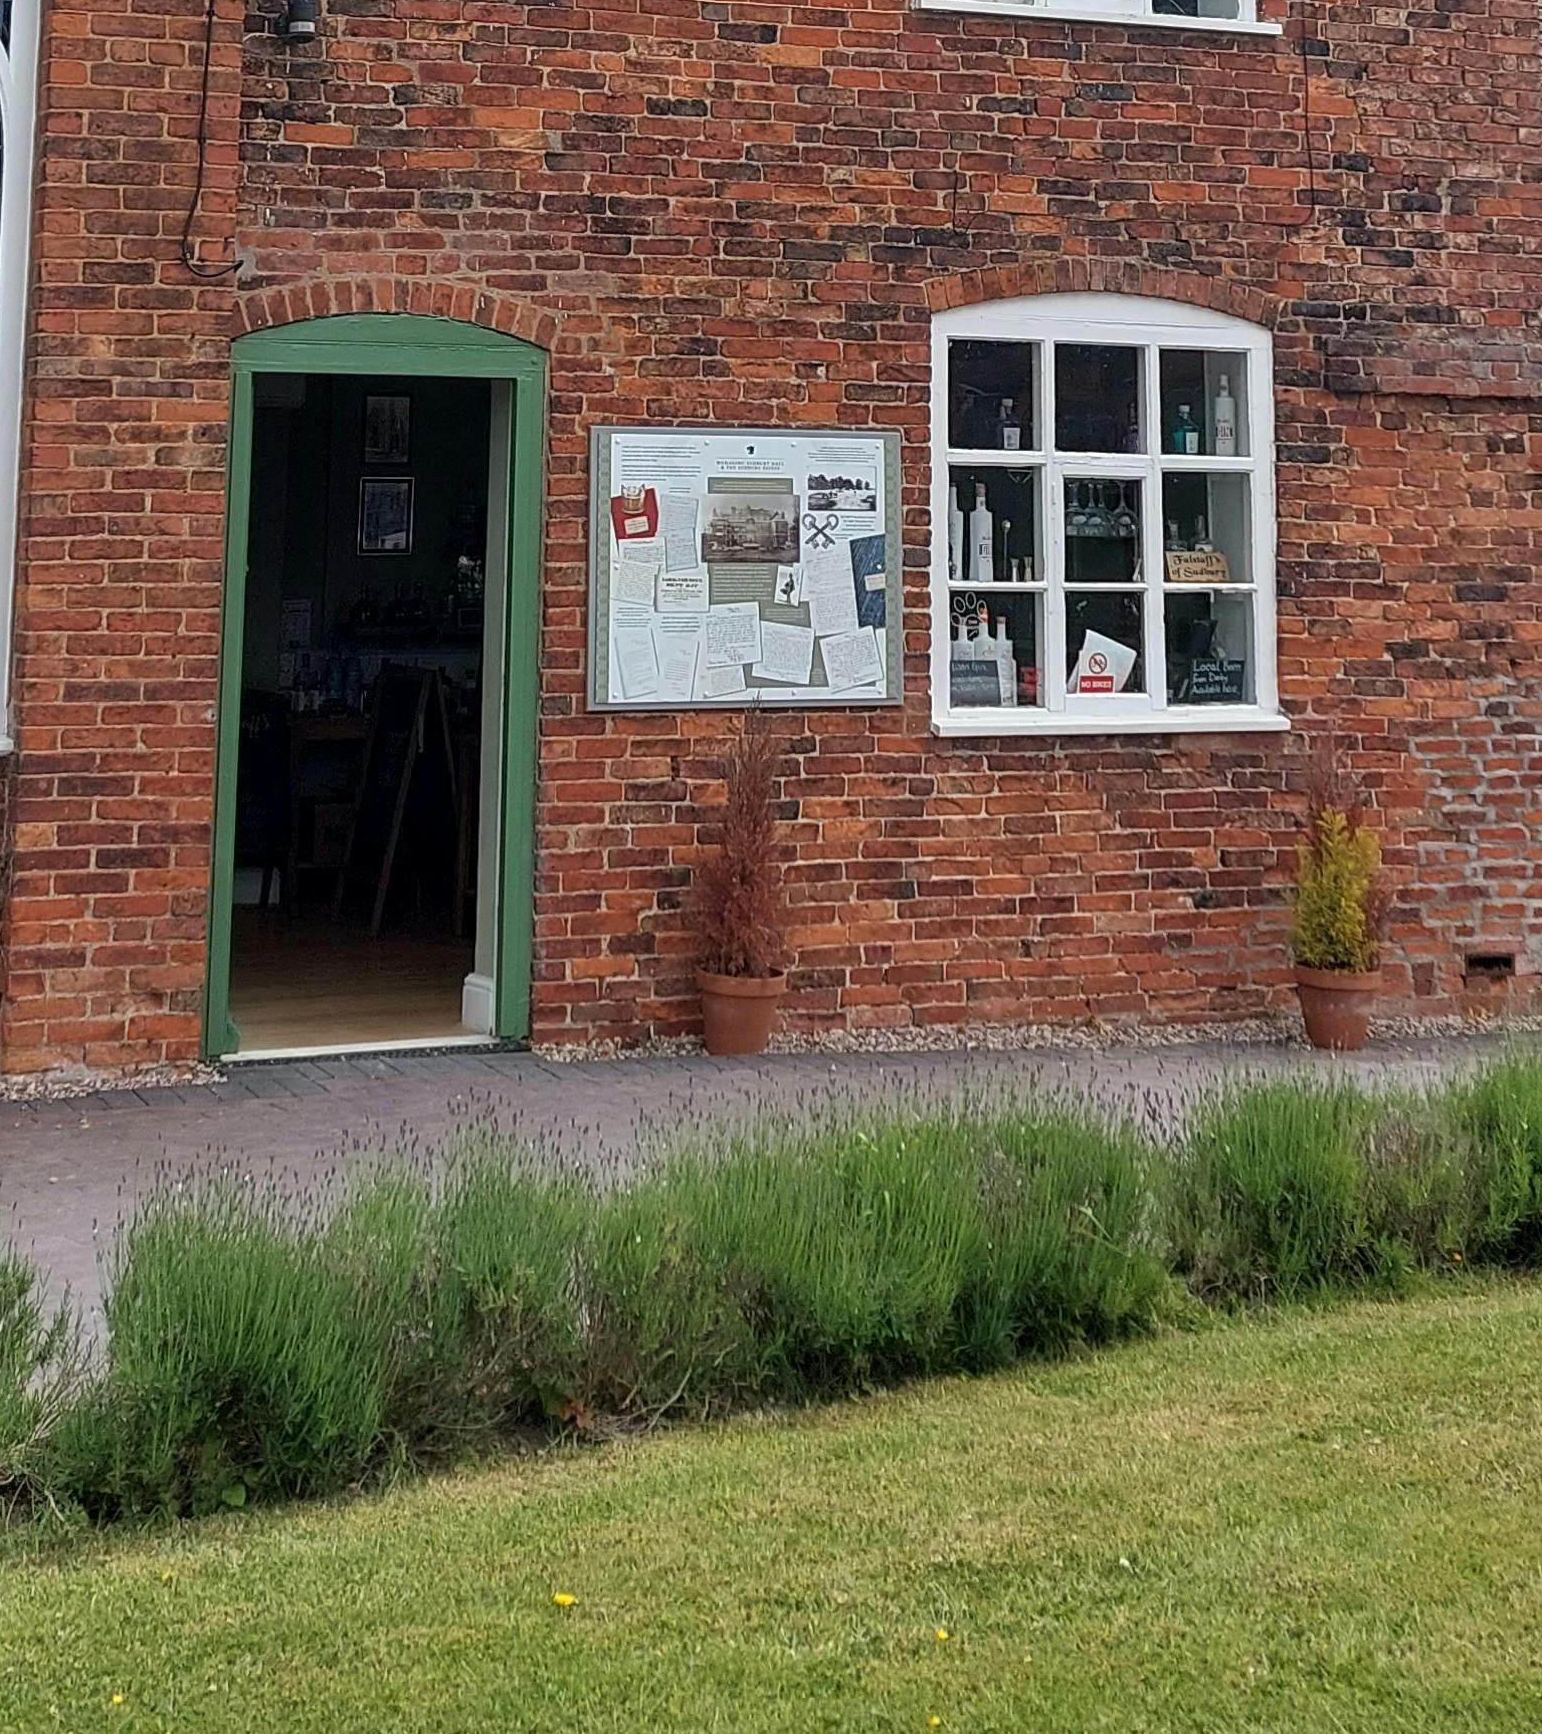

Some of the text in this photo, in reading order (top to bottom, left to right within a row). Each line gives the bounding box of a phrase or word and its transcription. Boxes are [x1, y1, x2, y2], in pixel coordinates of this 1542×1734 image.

[1171, 567, 1227, 579] of Sudbury
[1193, 659, 1221, 672] Local
